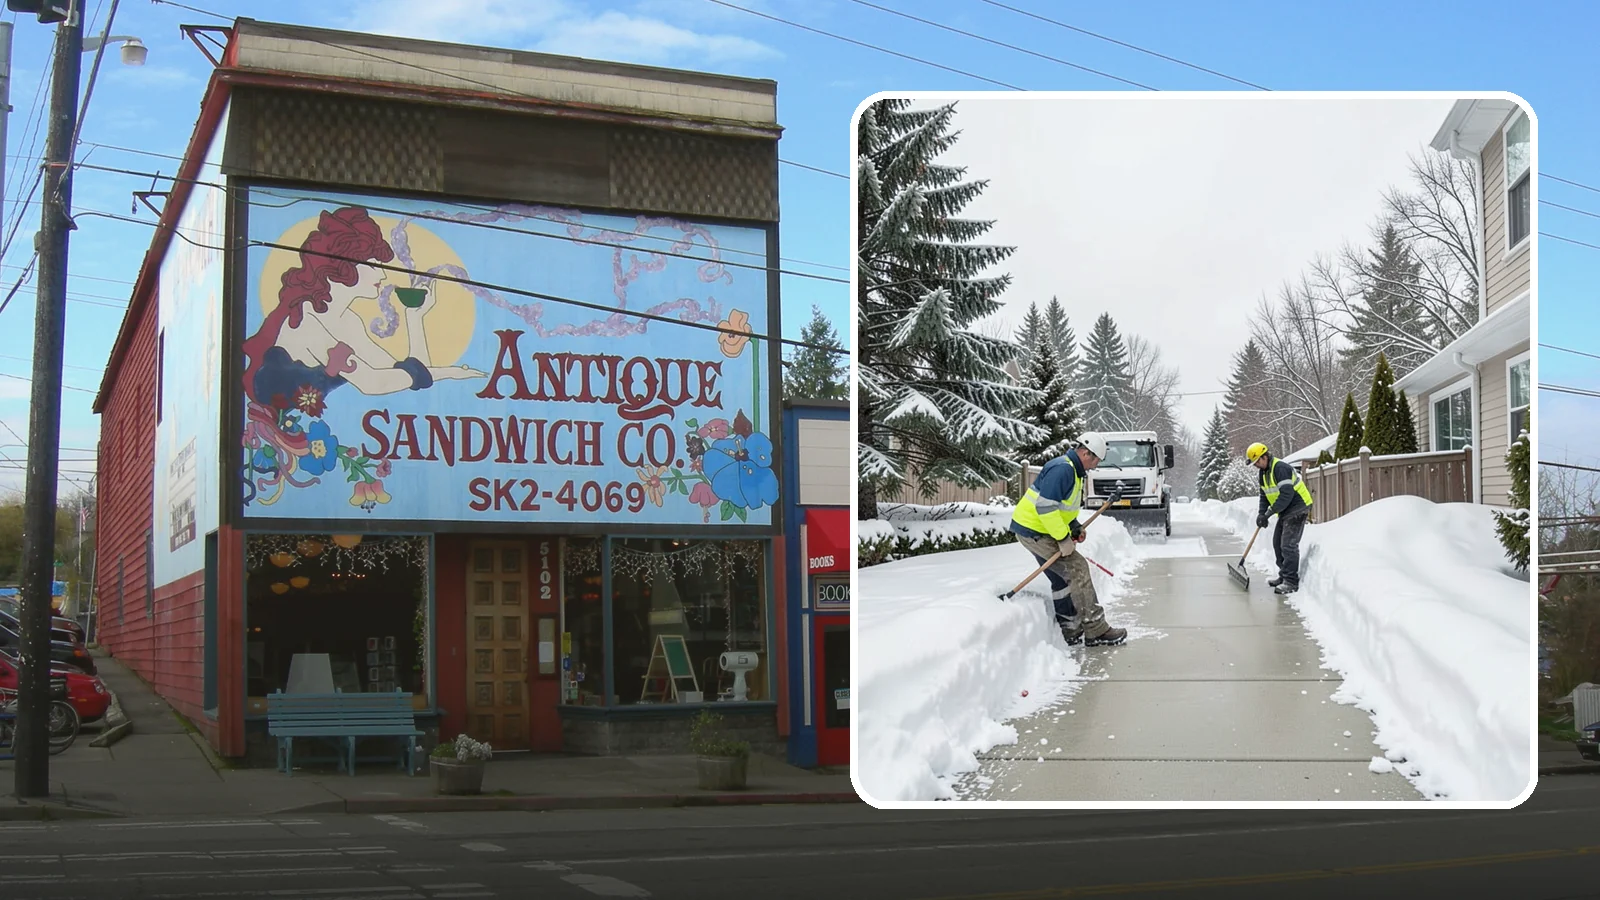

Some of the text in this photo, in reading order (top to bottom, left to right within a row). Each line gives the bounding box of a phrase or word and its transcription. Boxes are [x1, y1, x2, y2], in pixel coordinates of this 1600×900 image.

[475, 329, 724, 421] ANTIQUE
[361, 408, 685, 469] SANDWICH CO.
[468, 477, 646, 513] SK2-4069
[539, 541, 552, 600] 5102
[809, 555, 835, 569] BOOKS
